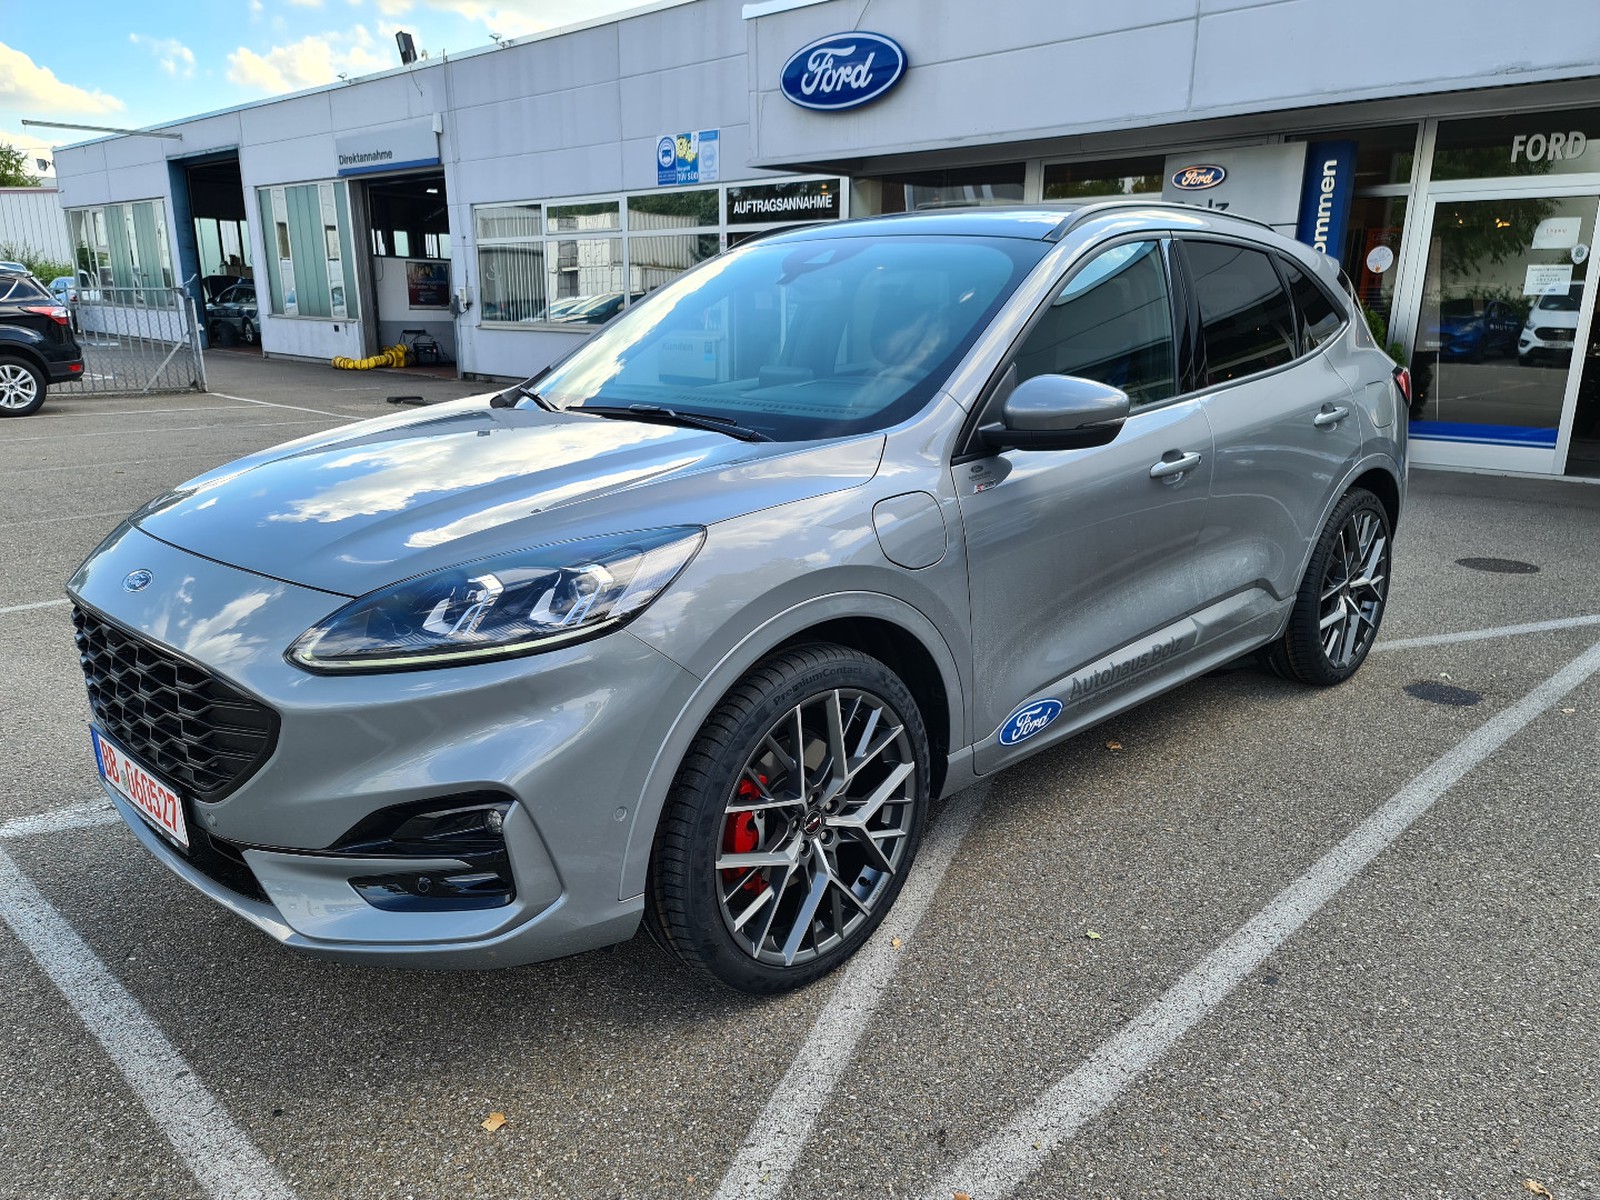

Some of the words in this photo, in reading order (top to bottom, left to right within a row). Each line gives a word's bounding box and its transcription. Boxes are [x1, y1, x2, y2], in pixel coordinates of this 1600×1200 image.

[800, 45, 876, 96] Ford
[338, 149, 393, 165] Direktannahme
[1510, 131, 1587, 163] FORD
[1181, 168, 1214, 187] Ford
[733, 194, 833, 215] AUFTRAGSANNAHME
[1068, 652, 1150, 701] Autohaus
[1151, 636, 1182, 661] Bolz
[1011, 707, 1052, 741] Ford
[100, 739, 119, 784] BB
